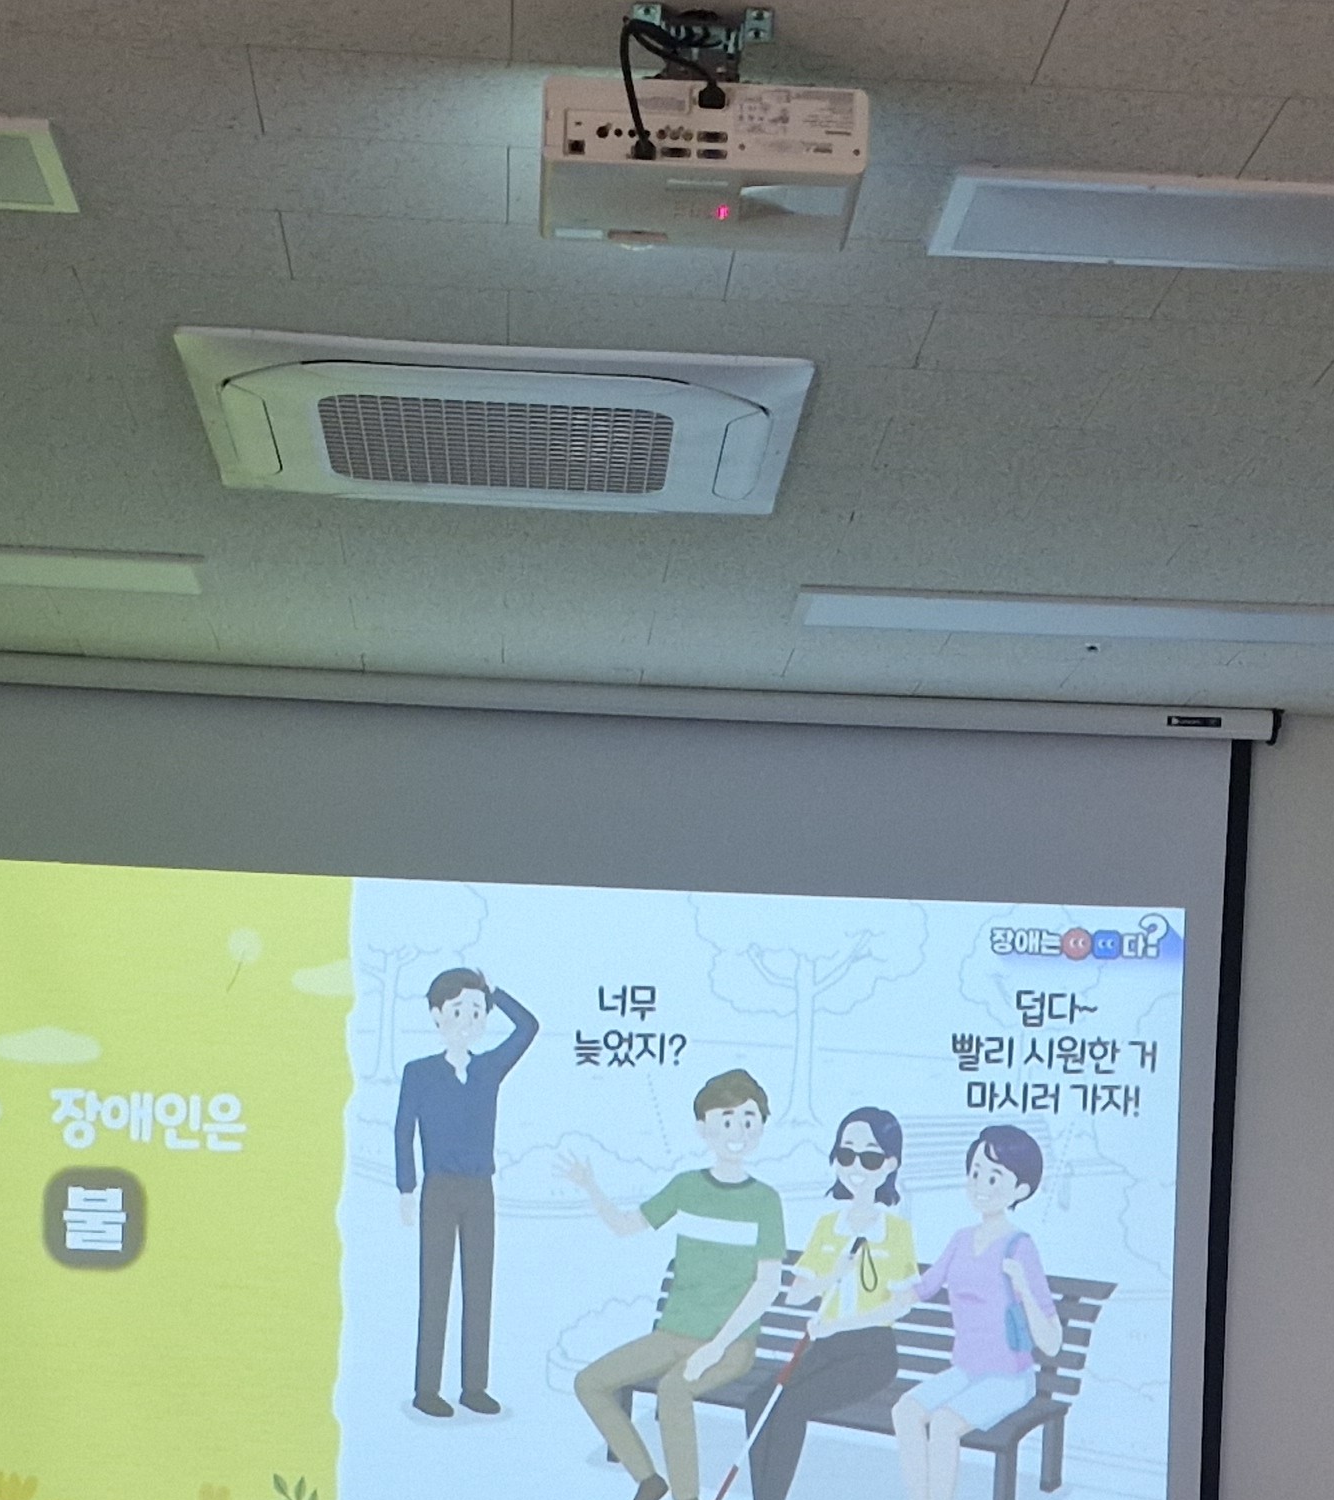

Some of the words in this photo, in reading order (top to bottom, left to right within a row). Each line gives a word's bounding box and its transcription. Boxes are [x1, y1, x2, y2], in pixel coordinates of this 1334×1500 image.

[598, 984, 656, 1021] 너무
[1015, 989, 1098, 1027] 덥다~
[574, 1029, 687, 1067] 늦었지?
[951, 1033, 1014, 1071] 빨리
[1023, 1035, 1121, 1074] 시원한
[1128, 1040, 1158, 1073] 거
[966, 1080, 1060, 1115] 마시러
[1069, 1083, 1140, 1117] 가자!
[50, 1087, 248, 1153] 장애인은
